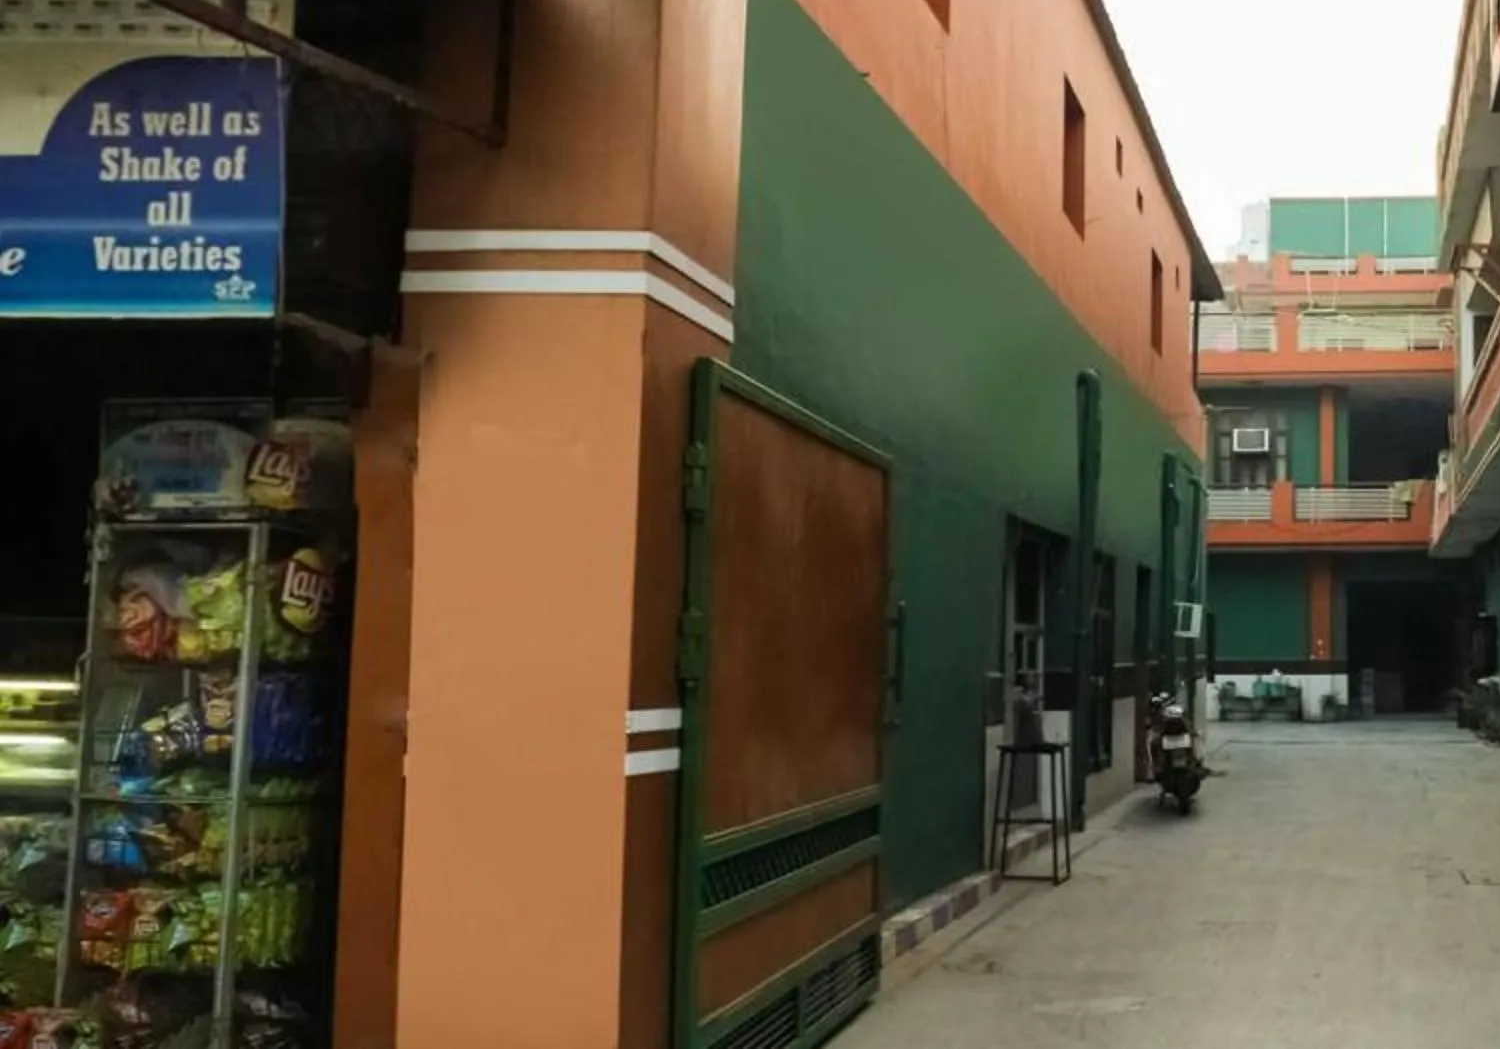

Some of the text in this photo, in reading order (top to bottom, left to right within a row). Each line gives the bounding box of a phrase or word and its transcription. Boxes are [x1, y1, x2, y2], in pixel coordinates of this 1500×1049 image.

[89, 103, 261, 137] As well as
[100, 145, 247, 182] Shake of
[147, 191, 192, 227] all
[93, 235, 242, 272] Varieties
